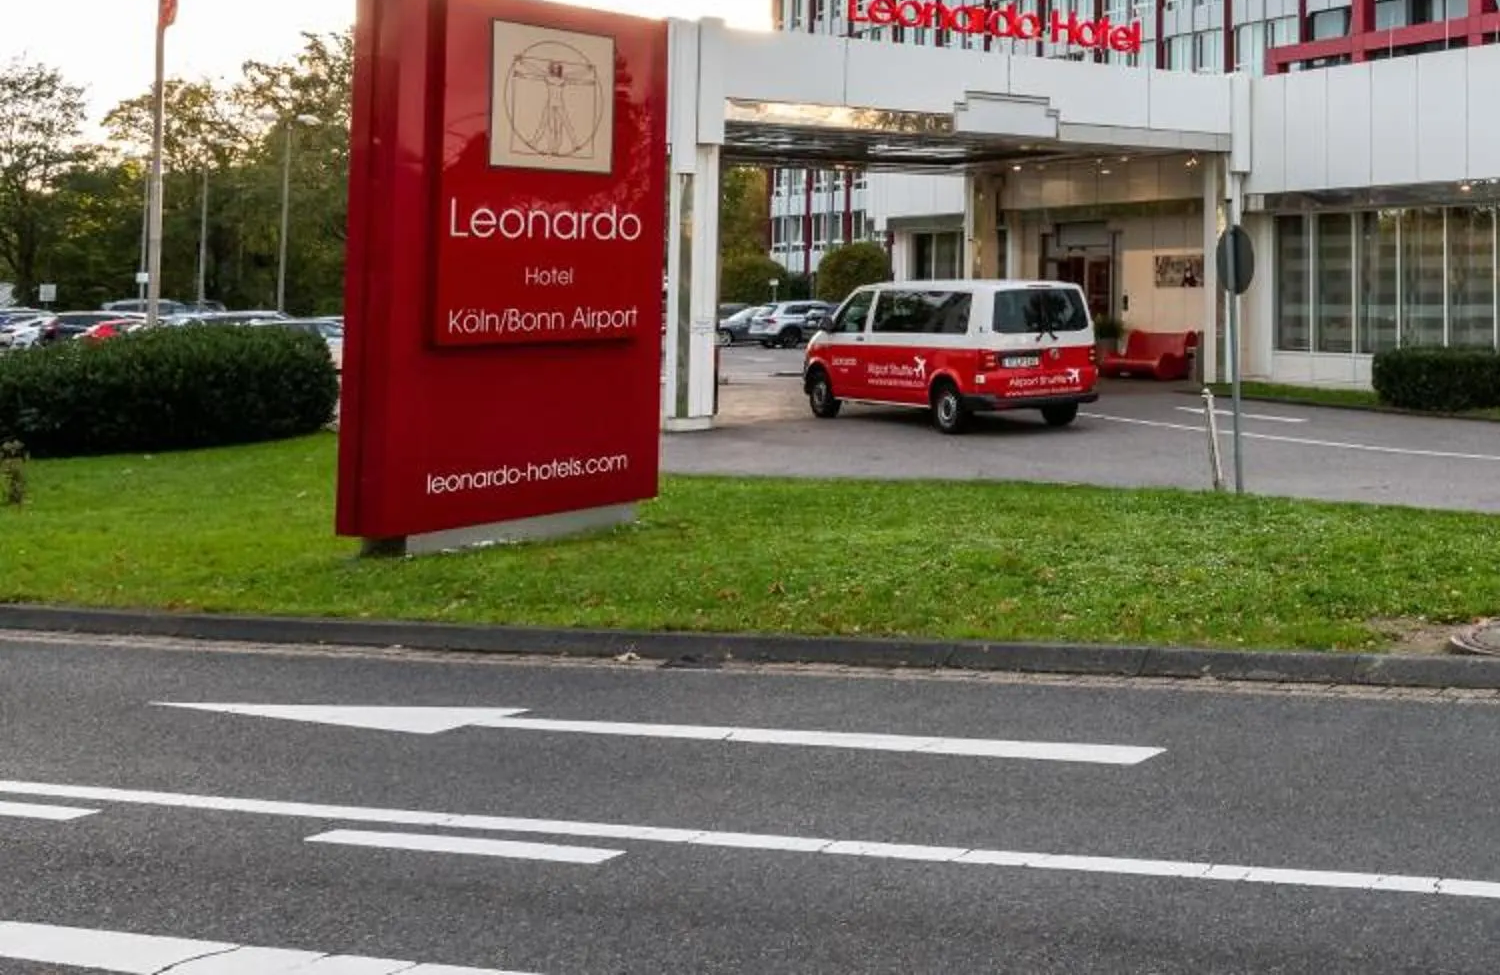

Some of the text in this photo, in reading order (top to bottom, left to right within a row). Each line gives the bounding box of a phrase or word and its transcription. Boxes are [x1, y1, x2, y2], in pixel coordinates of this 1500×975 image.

[1051, 9, 1142, 54] Hotel
[450, 197, 642, 241] Leonardo
[525, 266, 574, 286] Hotel
[448, 305, 638, 334] Köln/Bonn Airport
[425, 453, 628, 495] leonardo-hotels.com
